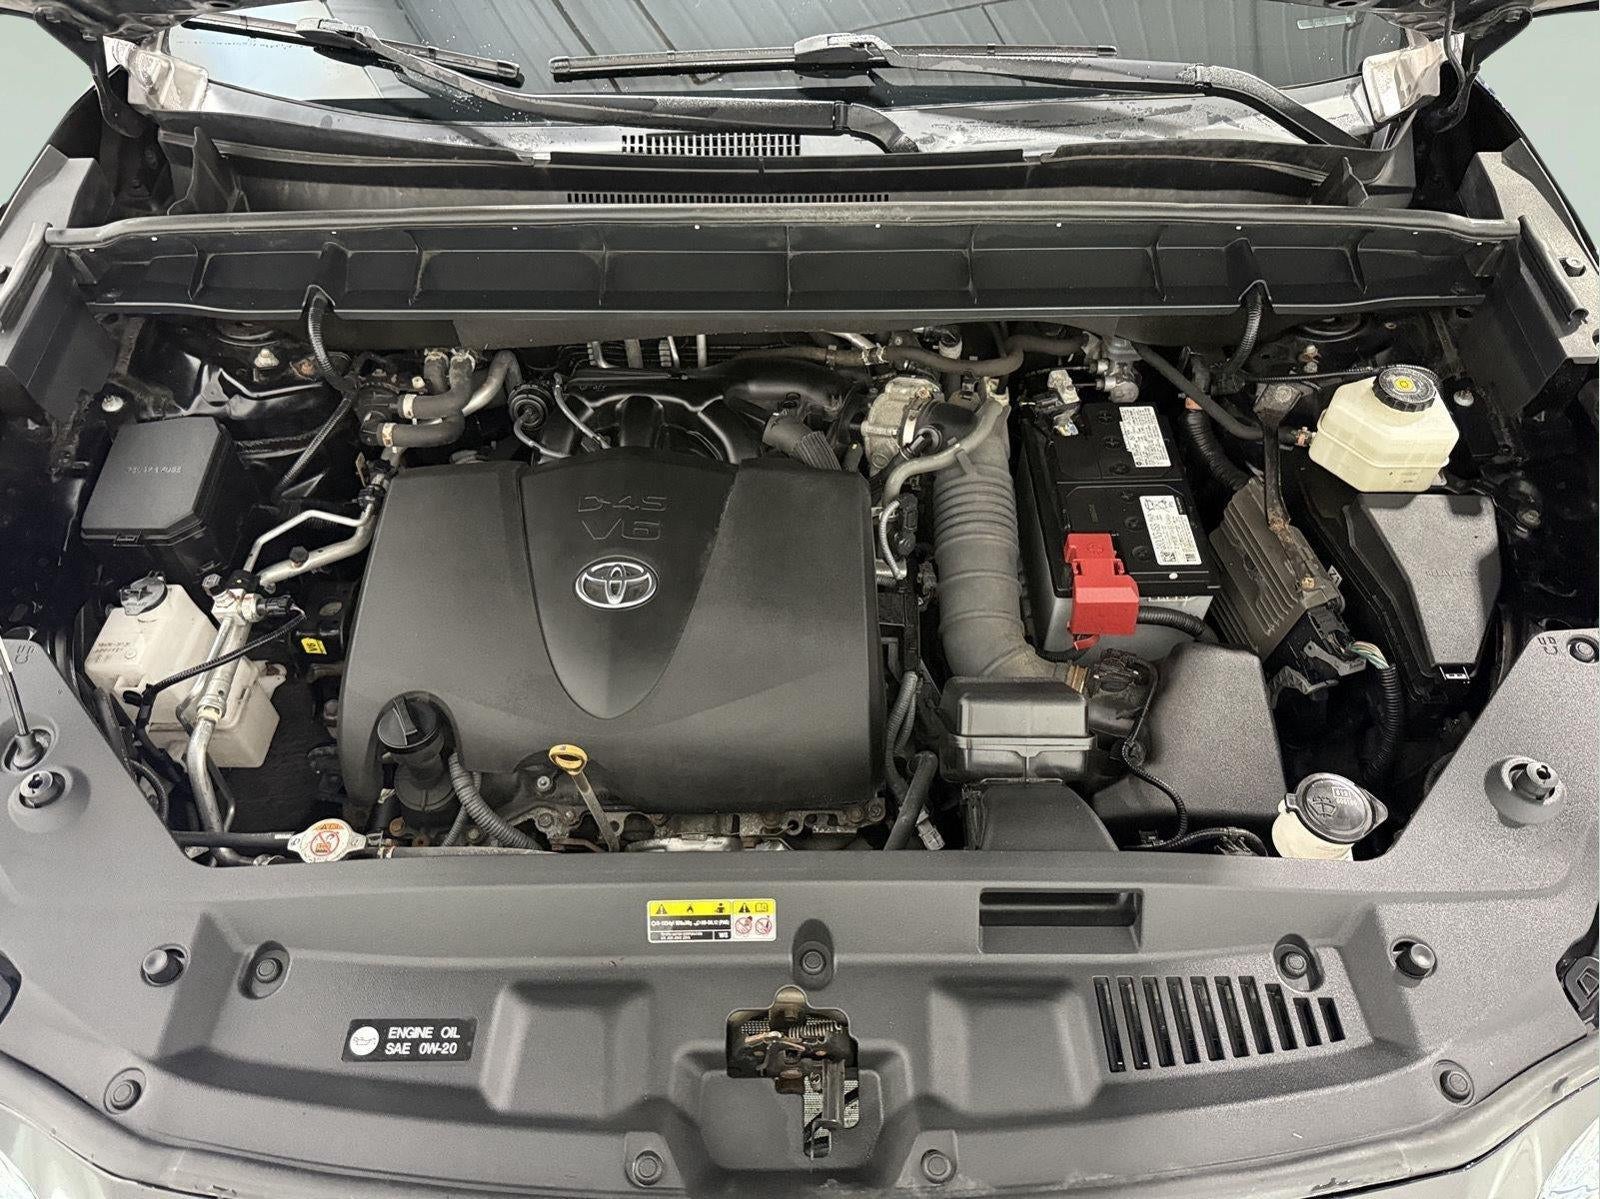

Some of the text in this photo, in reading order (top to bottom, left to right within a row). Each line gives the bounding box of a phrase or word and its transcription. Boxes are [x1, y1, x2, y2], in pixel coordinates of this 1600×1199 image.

[581, 517, 661, 541] V6
[388, 1026, 461, 1039] ENGINE OIL
[385, 1042, 458, 1055] SAE 0W-20
